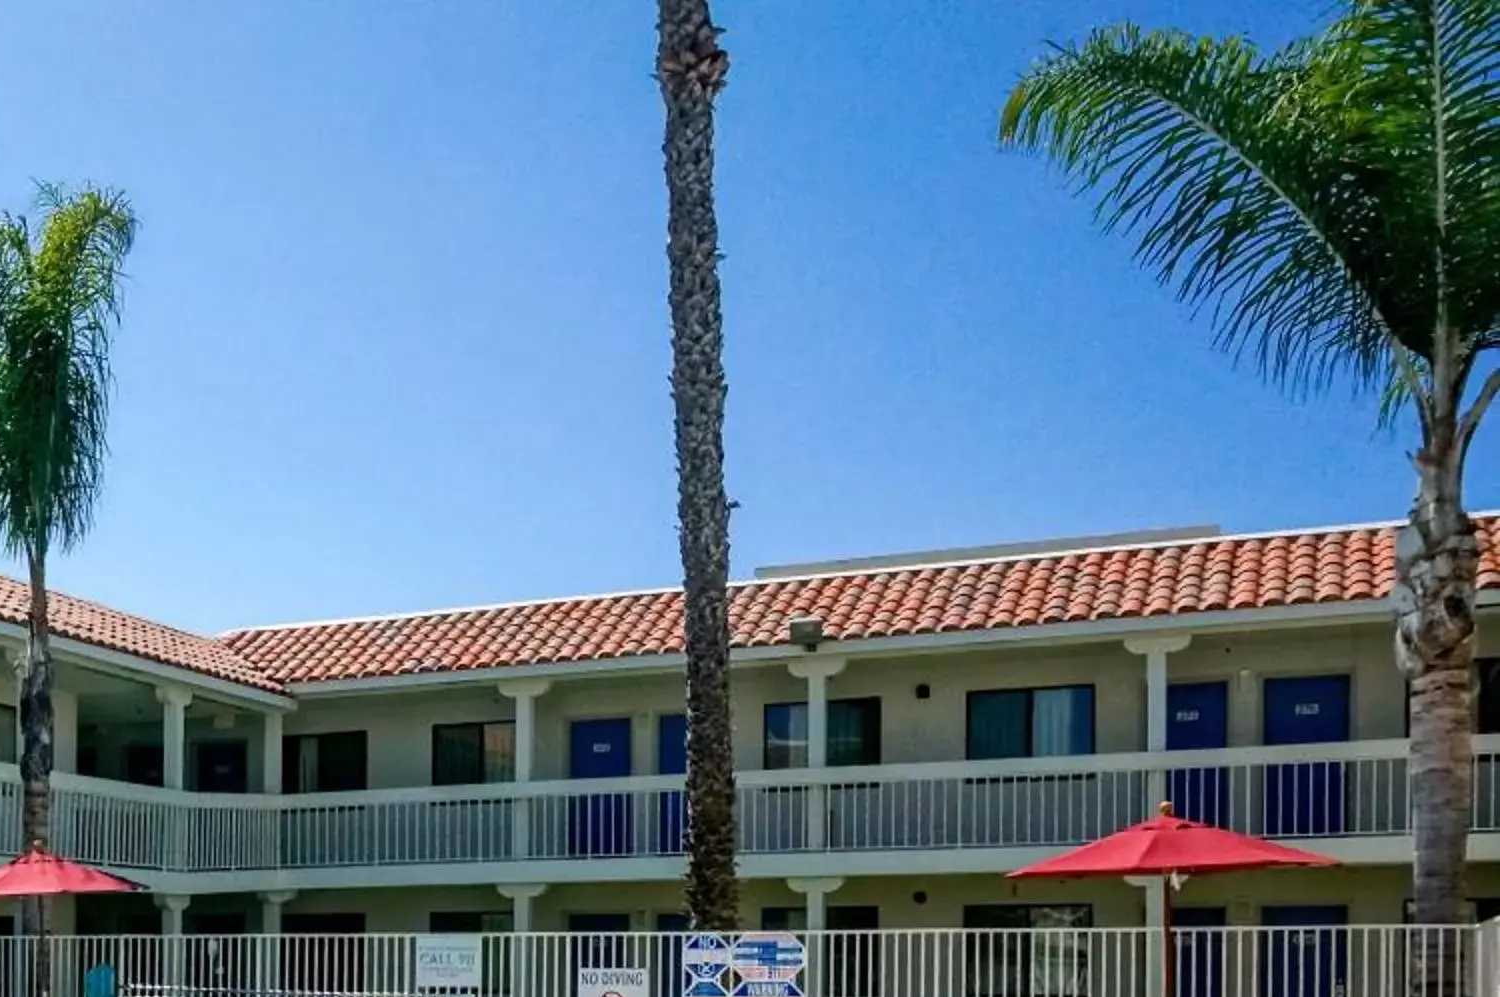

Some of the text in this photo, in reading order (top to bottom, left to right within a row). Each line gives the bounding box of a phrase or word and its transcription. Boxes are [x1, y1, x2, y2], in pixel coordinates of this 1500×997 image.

[420, 953, 452, 964] CALL
[581, 971, 642, 986] NO DIVING
